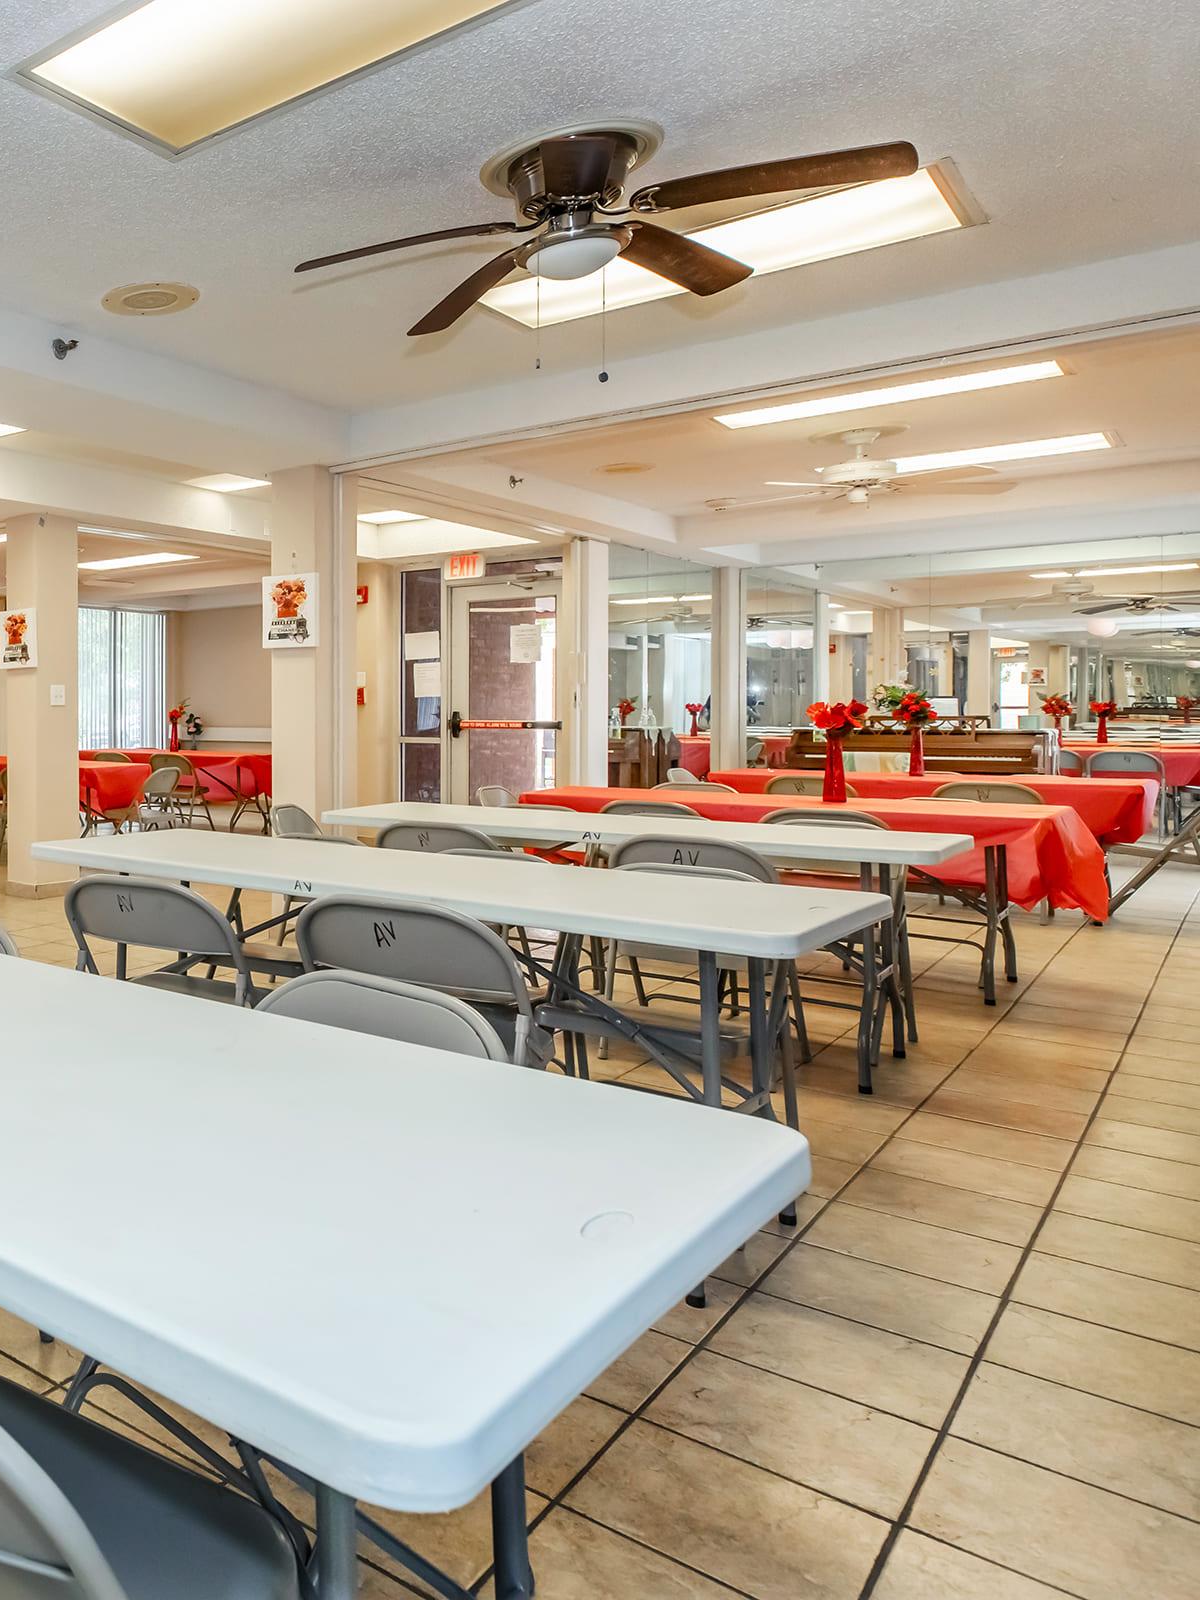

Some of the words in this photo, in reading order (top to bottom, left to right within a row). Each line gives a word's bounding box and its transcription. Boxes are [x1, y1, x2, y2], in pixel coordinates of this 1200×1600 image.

[450, 555, 480, 577] EXIT
[582, 831, 601, 840] AV
[672, 848, 700, 866] AV
[293, 879, 312, 893] AV
[116, 891, 134, 913] AV
[373, 919, 397, 948] AV
